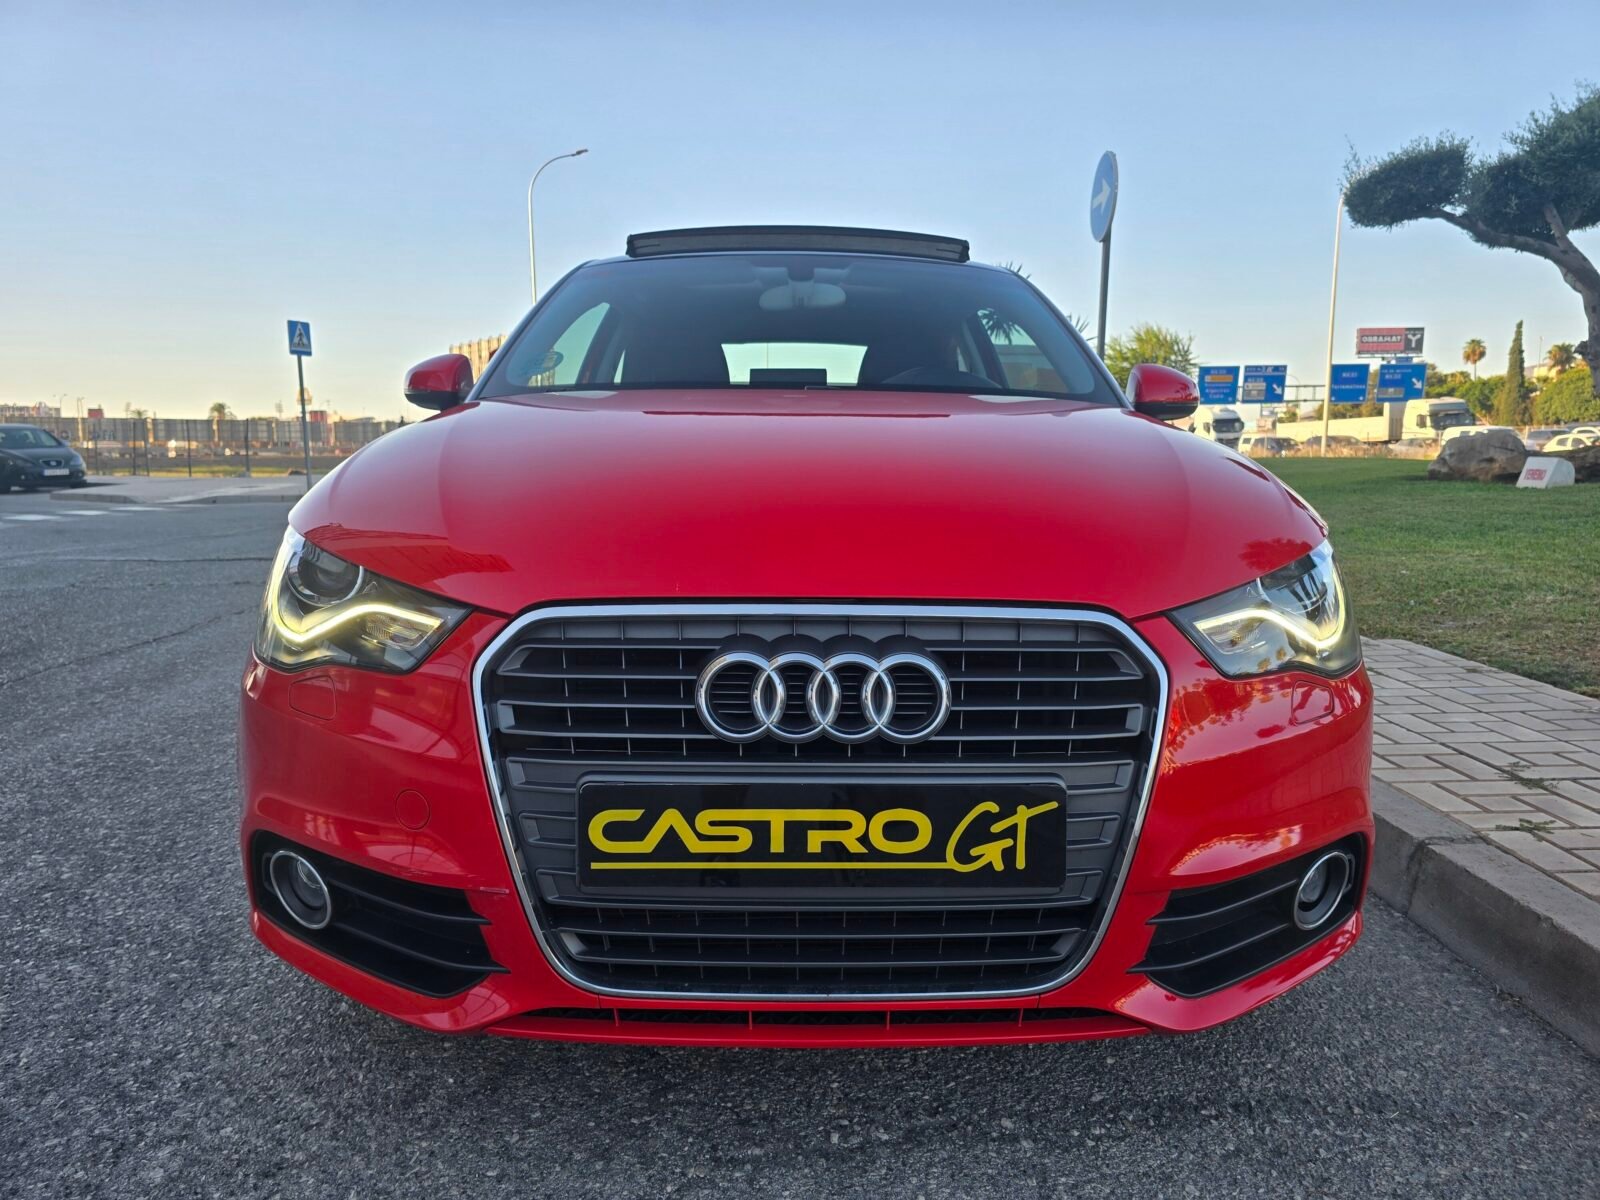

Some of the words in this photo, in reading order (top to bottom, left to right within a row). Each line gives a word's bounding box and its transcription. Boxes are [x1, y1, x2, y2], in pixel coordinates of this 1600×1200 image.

[1361, 335, 1402, 343] OBRAMAT
[588, 808, 932, 854] CASTRO
[945, 801, 1059, 873] GT
